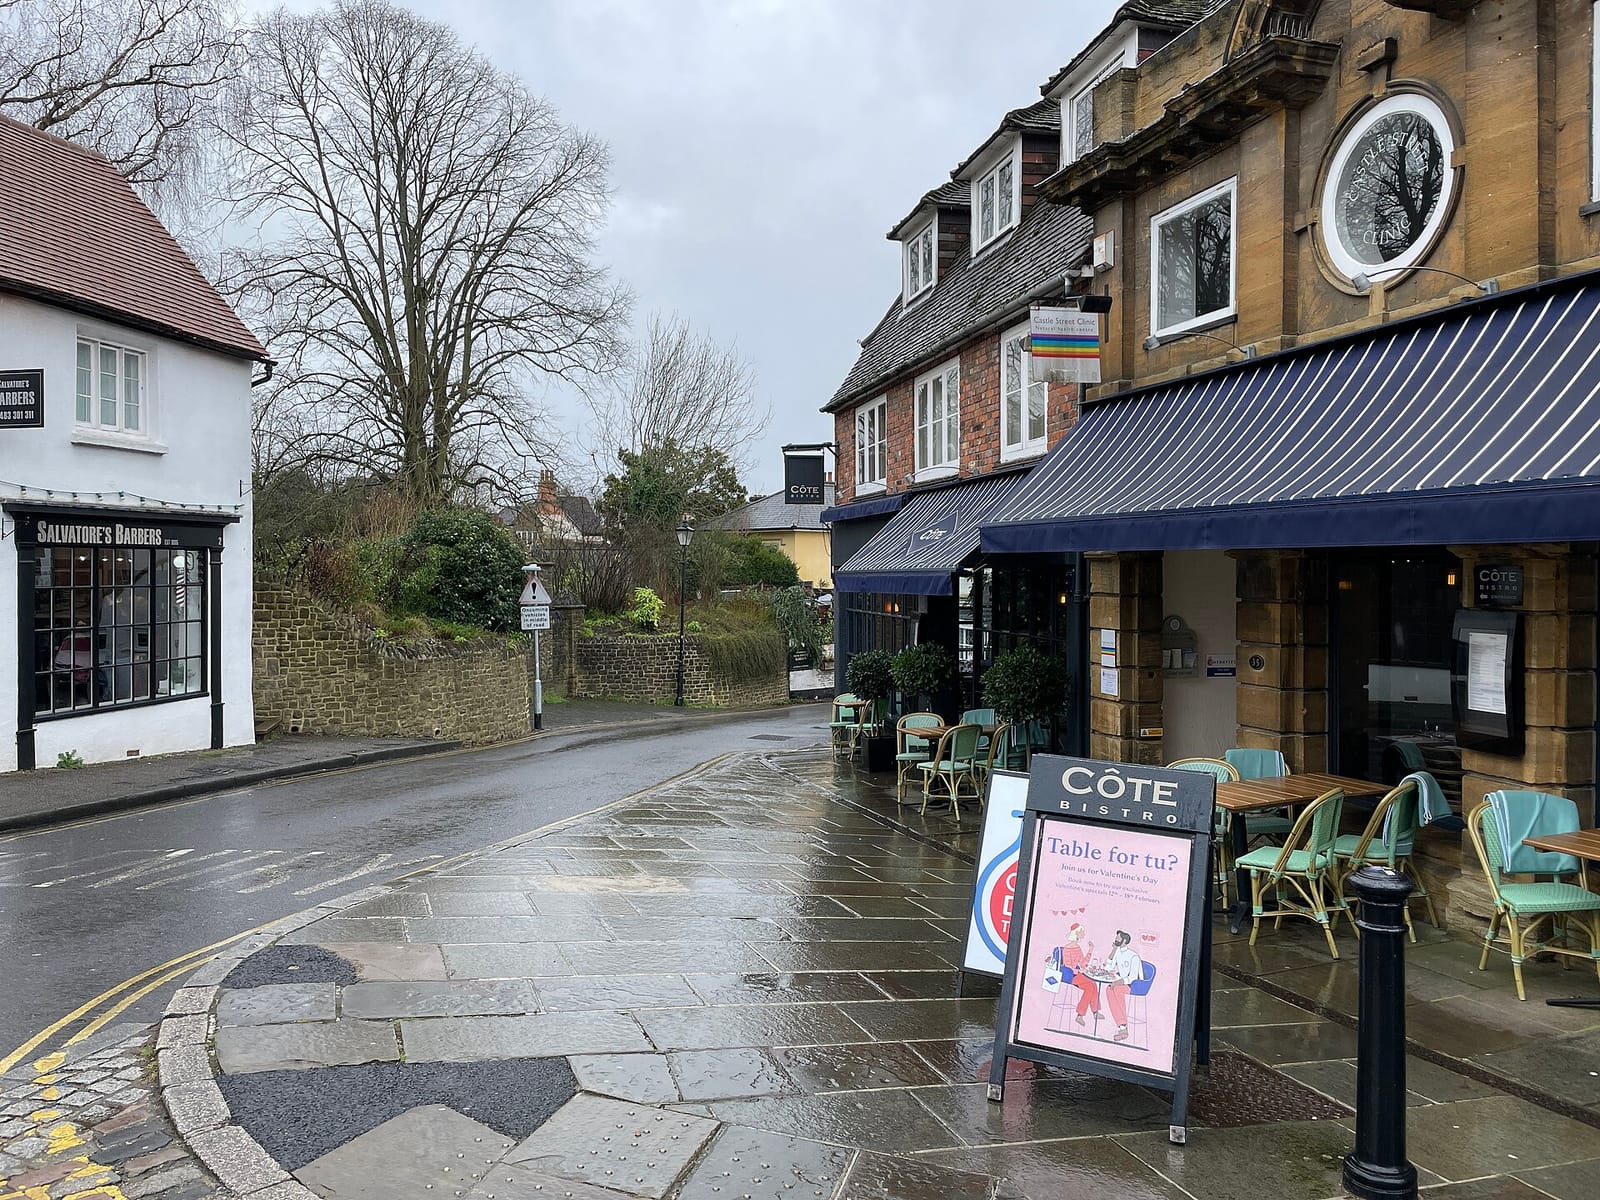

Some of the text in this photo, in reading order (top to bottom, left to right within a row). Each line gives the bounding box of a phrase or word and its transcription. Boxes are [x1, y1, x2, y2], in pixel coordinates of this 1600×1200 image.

[1349, 131, 1430, 202] CASTLE STREET
[1363, 215, 1412, 246] CLINIC
[1033, 316, 1096, 326] Castle Street Clinic
[0, 380, 30, 389] ALVATORE'S
[0, 391, 35, 406] ARBERS
[790, 484, 820, 494] CÔTE
[37, 520, 113, 544] SALVATORE'S
[115, 523, 162, 546] BARBERS
[217, 536, 223, 546] 2
[1479, 568, 1518, 582] CÔTE
[1479, 584, 1519, 592] BISTRO
[1061, 766, 1179, 807] CÔTE
[1059, 800, 1178, 824] BISTRO
[1047, 837, 1178, 871] Table for tu?
[1061, 863, 1076, 872] Join
[1087, 867, 1099, 875] for
[1100, 868, 1141, 882] Valentine's
[1142, 875, 1159, 886] Day
